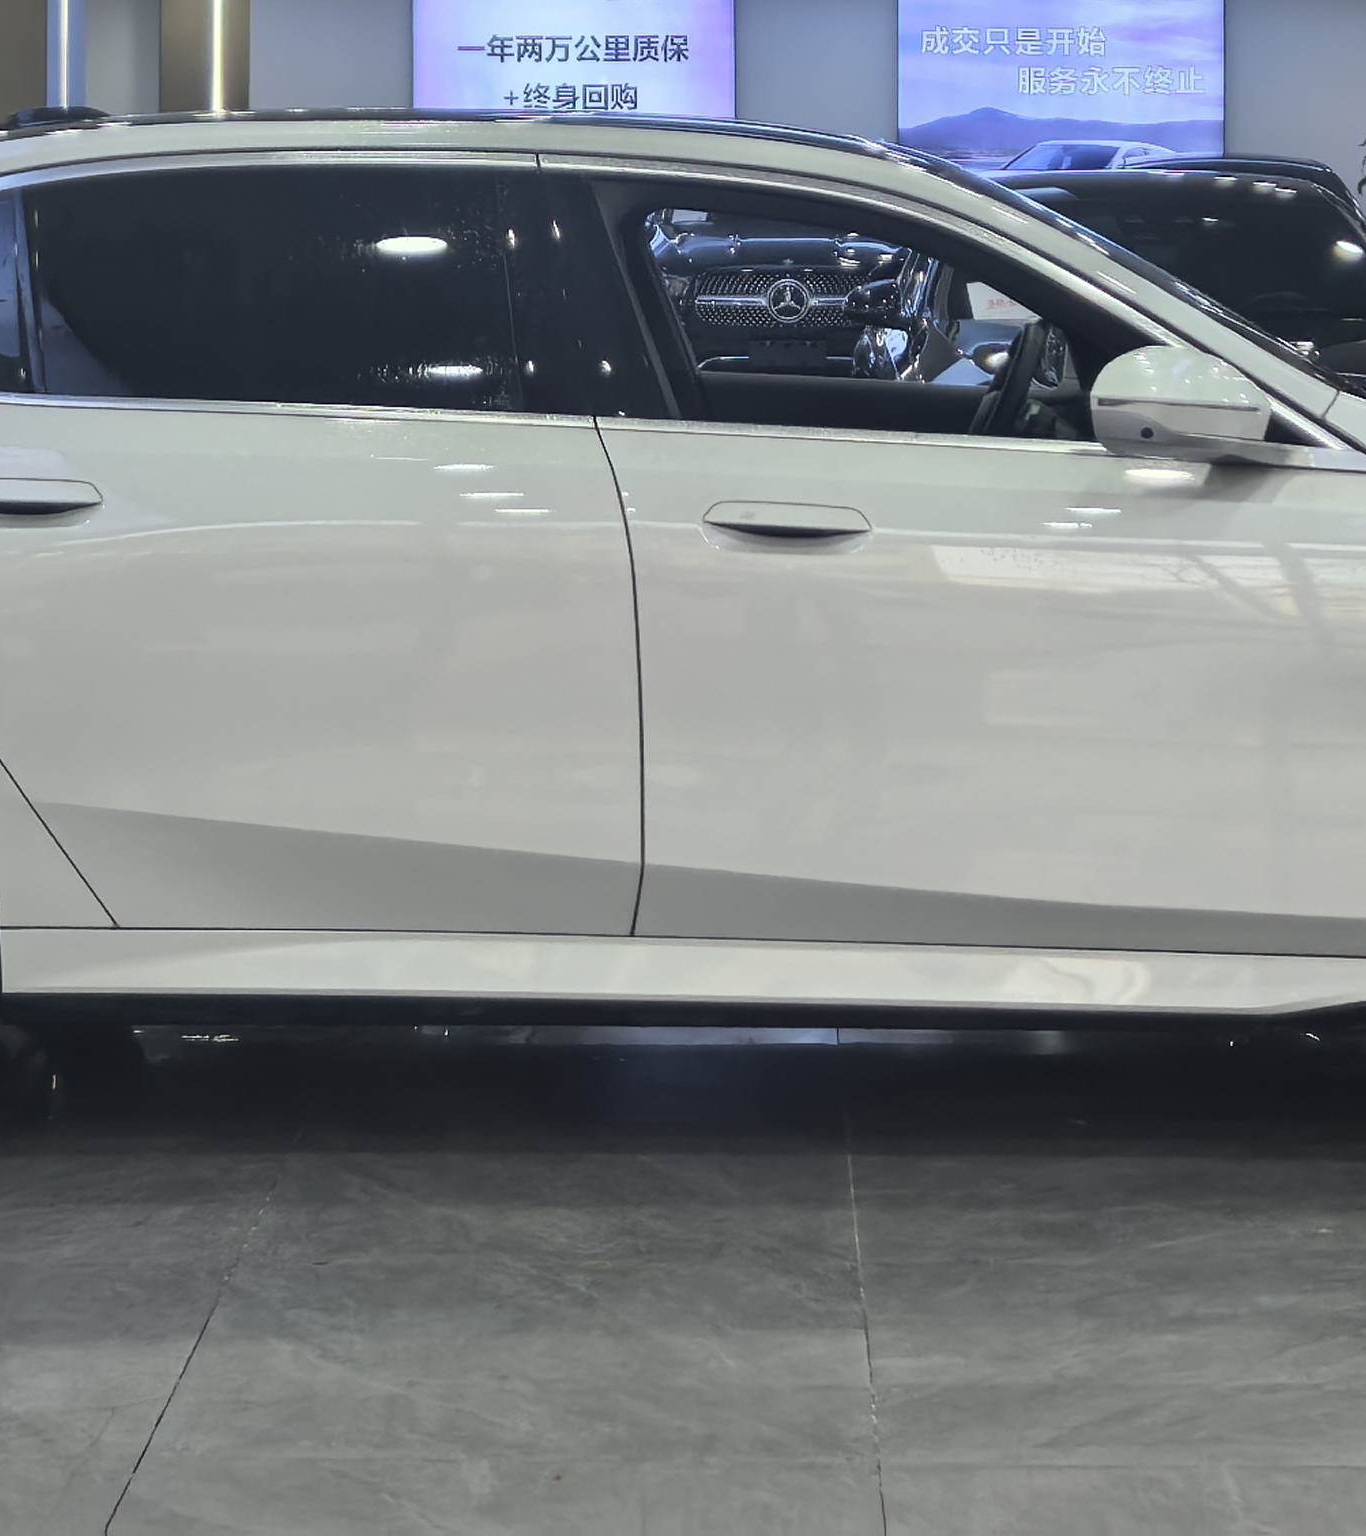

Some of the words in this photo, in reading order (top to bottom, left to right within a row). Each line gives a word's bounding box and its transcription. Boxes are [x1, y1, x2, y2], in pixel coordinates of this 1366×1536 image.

[457, 34, 690, 63] 一年两万公里质保
[920, 25, 1107, 56] 成交只是开始
[1017, 65, 1205, 96] 服务永不终止
[503, 82, 638, 111] +终身回购
